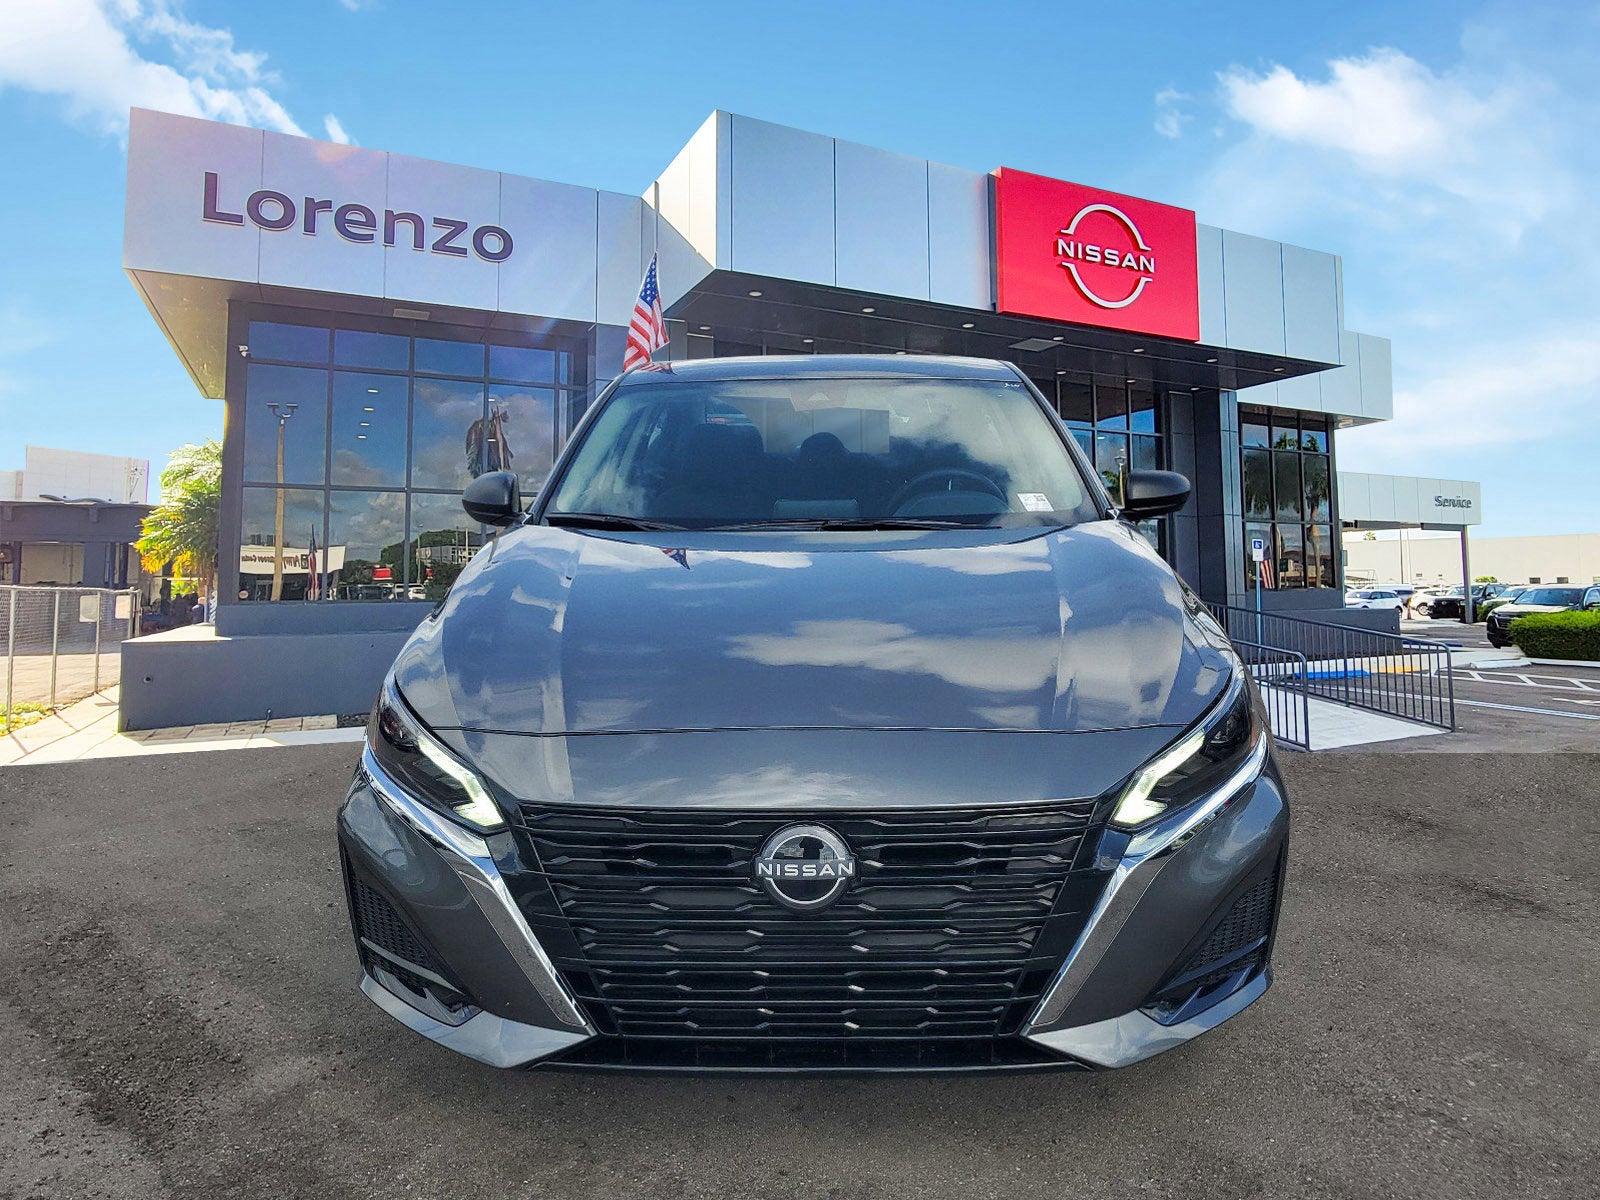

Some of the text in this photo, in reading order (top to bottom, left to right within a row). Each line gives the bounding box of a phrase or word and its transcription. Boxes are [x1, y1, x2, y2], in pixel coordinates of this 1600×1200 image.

[202, 171, 514, 262] Lorenzo
[1057, 238, 1155, 273] NISSAN
[1434, 495, 1472, 509] Service
[758, 862, 853, 877] NISSAN
